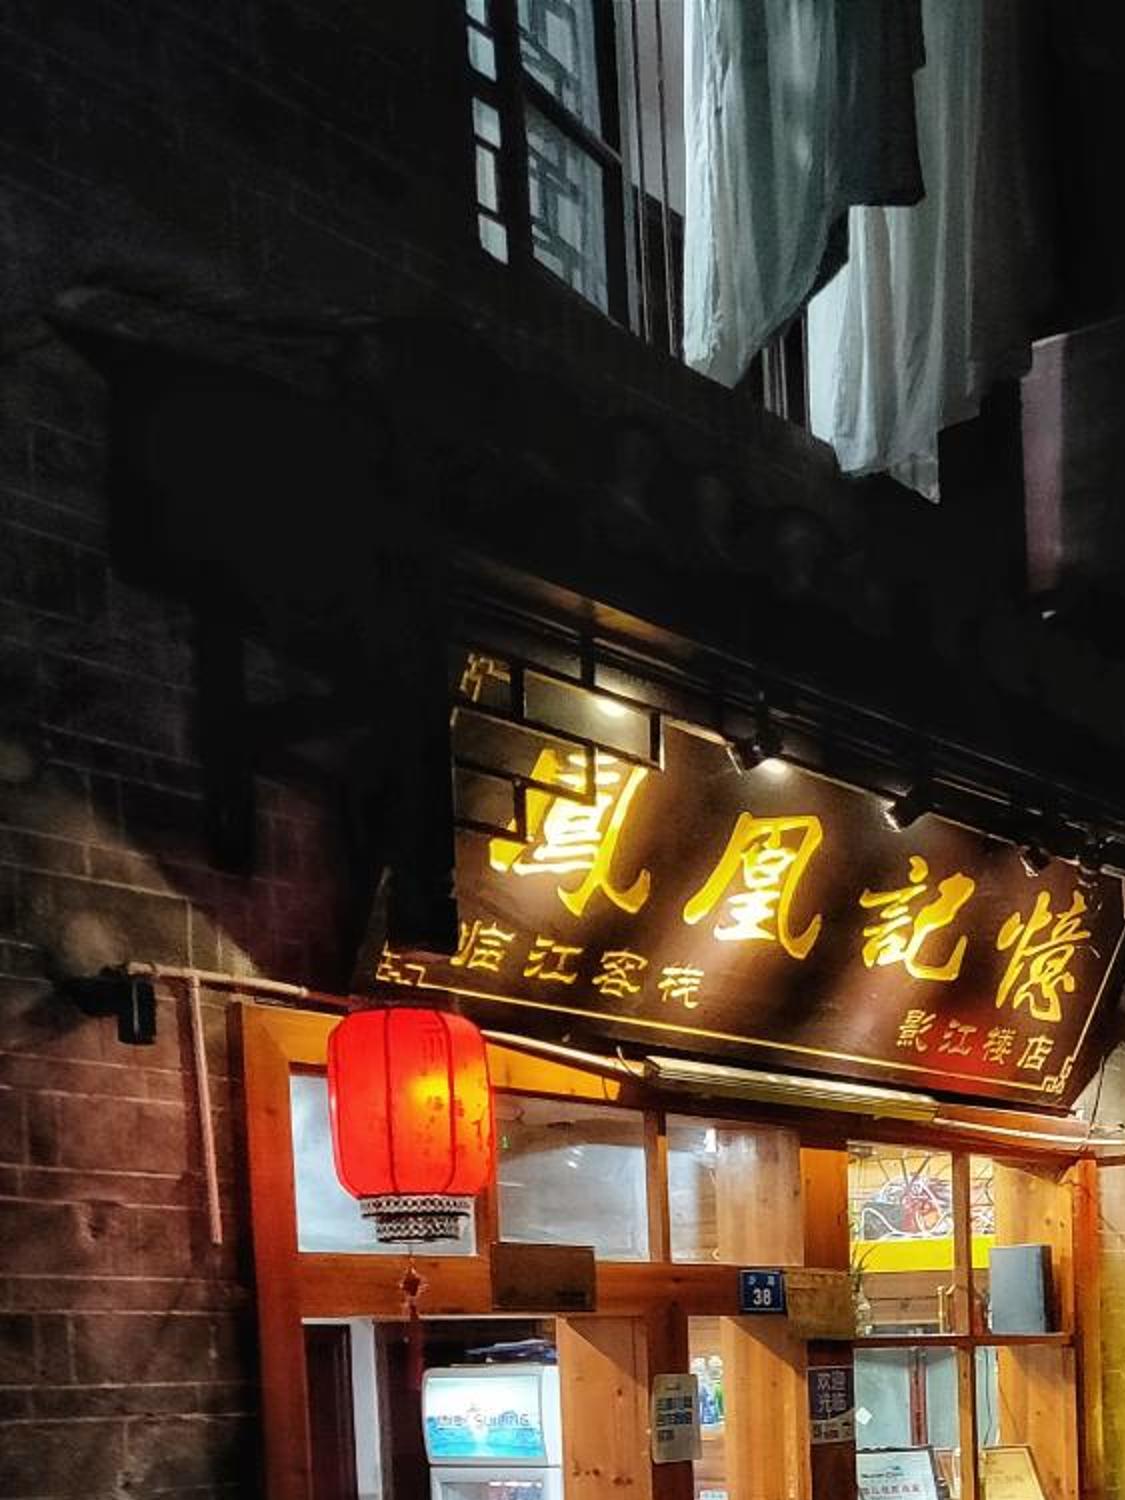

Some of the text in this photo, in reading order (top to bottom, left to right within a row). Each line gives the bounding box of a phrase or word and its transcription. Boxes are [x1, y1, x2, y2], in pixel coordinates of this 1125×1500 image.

[489, 748, 1096, 1021] 鳳凰記憶
[753, 1288, 771, 1306] 38
